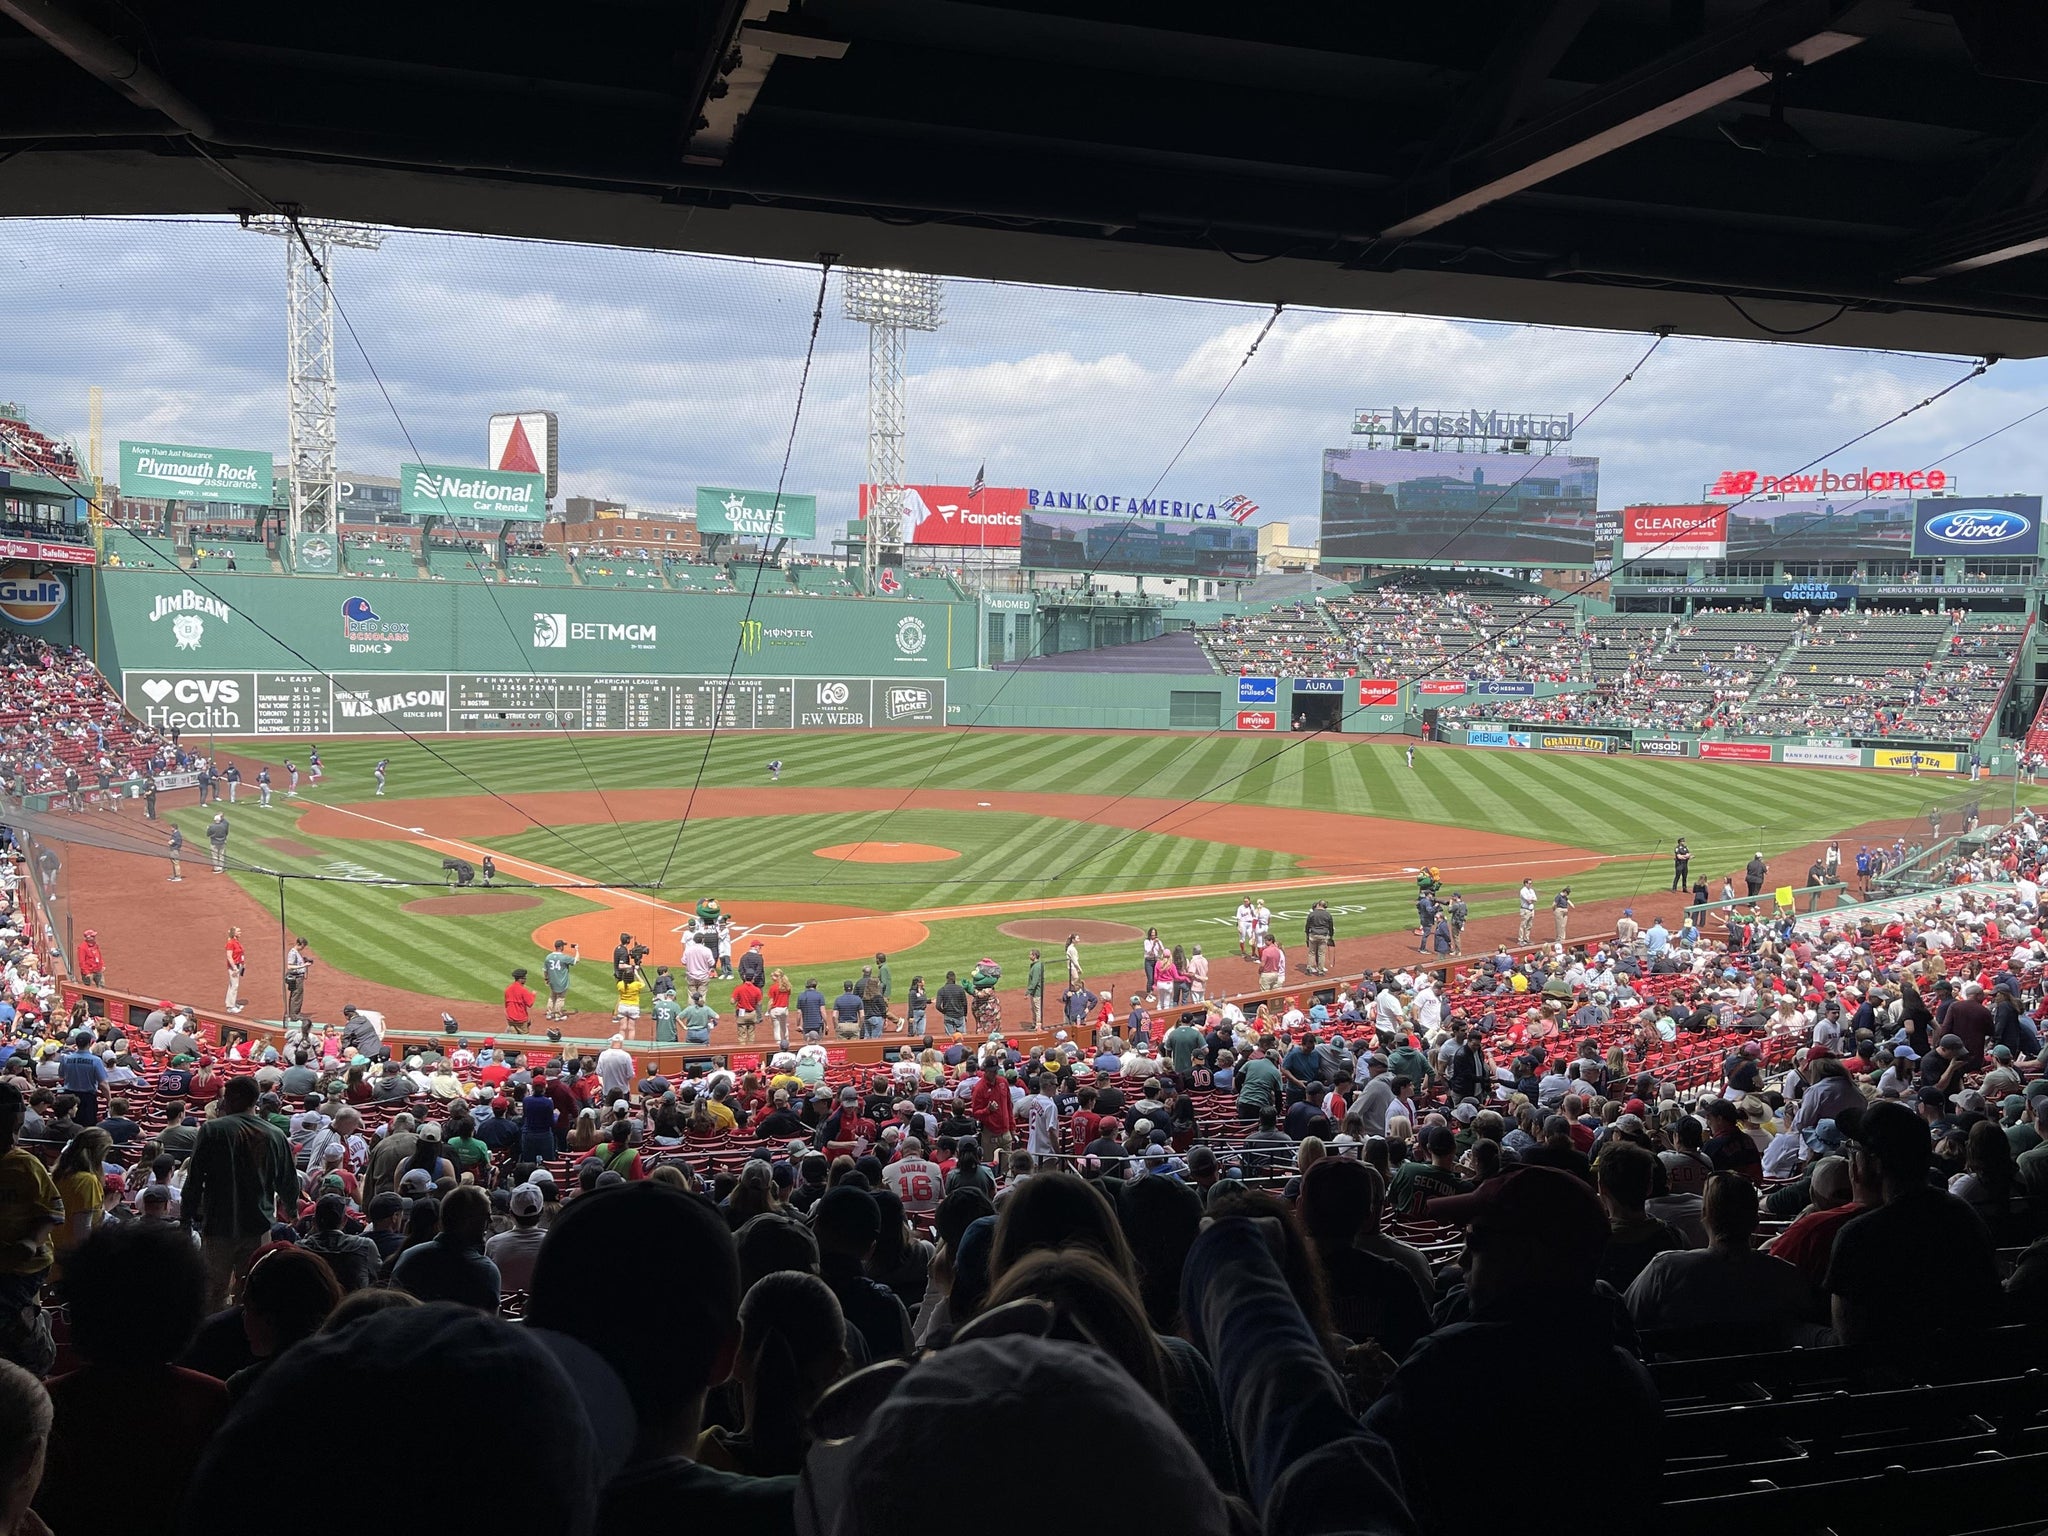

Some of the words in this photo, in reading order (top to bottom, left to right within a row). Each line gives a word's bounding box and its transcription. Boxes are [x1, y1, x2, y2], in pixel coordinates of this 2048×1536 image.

[1392, 406, 1574, 440] MassMutual
[132, 446, 150, 454] More
[152, 448, 167, 456] Than
[168, 449, 181, 457] Just
[137, 457, 213, 477] Plymouth
[217, 463, 258, 481] Rock
[442, 478, 531, 502] National
[474, 501, 490, 511] Car
[495, 502, 528, 513] Rental
[1028, 488, 1089, 510] BANK
[1095, 494, 1121, 512] OF
[1127, 497, 1217, 520] AMERICA
[725, 506, 786, 522] DRAFT
[960, 509, 1021, 525] Fanatics
[733, 520, 785, 534] KINGS
[1634, 516, 1717, 530] CLEAResult
[1944, 514, 2008, 538] Ford
[0, 581, 60, 602] Gulf
[1791, 583, 1829, 592] ANGRY
[1783, 590, 1838, 600] ORCHARD
[149, 594, 183, 622] JIM
[182, 589, 231, 624] BEAM
[991, 600, 1030, 609] ABIOMED
[349, 621, 378, 632] RED
[381, 622, 410, 633] SOX
[571, 622, 656, 641] BETMGM
[763, 627, 814, 639] MONSTER
[349, 632, 410, 641] SCHOLARS
[349, 643, 382, 653] BIDMC
[174, 679, 240, 704] CVS
[1241, 683, 1253, 692] city
[1438, 684, 1464, 693] TICKET
[335, 692, 352, 700] WHO
[376, 690, 446, 714] MASON
[895, 689, 927, 703] ACE
[896, 702, 928, 713] TICKET
[145, 705, 241, 729] Health
[801, 713, 823, 725] F.W.
[827, 713, 864, 725] WEBB
[1243, 717, 1270, 725] IRVING
[1380, 714, 1394, 722] 420
[1471, 733, 1503, 743] jetBlue
[1544, 736, 1583, 747] GRANITE
[1584, 738, 1605, 750] CITY
[1641, 741, 1681, 751] wasabi
[1889, 755, 1924, 766] TWISD
[1926, 758, 1940, 768] TEA
[549, 959, 561, 970] 34
[657, 1008, 671, 1020] 35
[159, 1075, 182, 1091] 28
[1192, 1069, 1211, 1087] 10
[900, 1164, 927, 1175] DURAN
[898, 1175, 933, 1203] 16
[1414, 1174, 1456, 1195] SECTION
